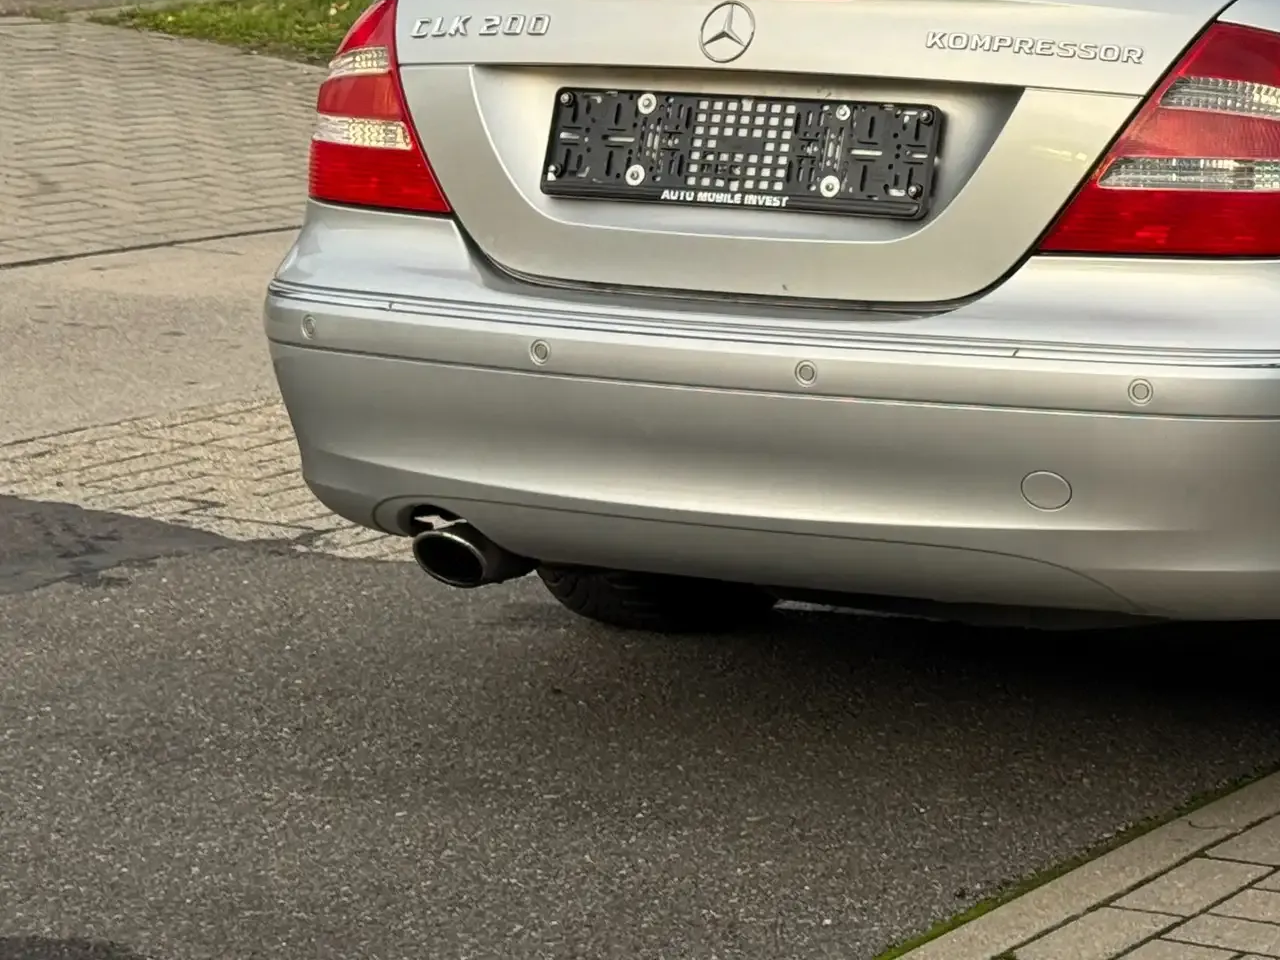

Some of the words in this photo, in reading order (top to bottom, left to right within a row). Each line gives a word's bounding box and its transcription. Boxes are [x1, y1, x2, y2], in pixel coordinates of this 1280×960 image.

[410, 15, 472, 39] CLK
[478, 13, 551, 36] 200
[925, 31, 1145, 64] KOMPRESSOR
[661, 189, 695, 201] AUTO
[697, 192, 742, 204] MOBILE
[744, 194, 789, 207] INVEST
